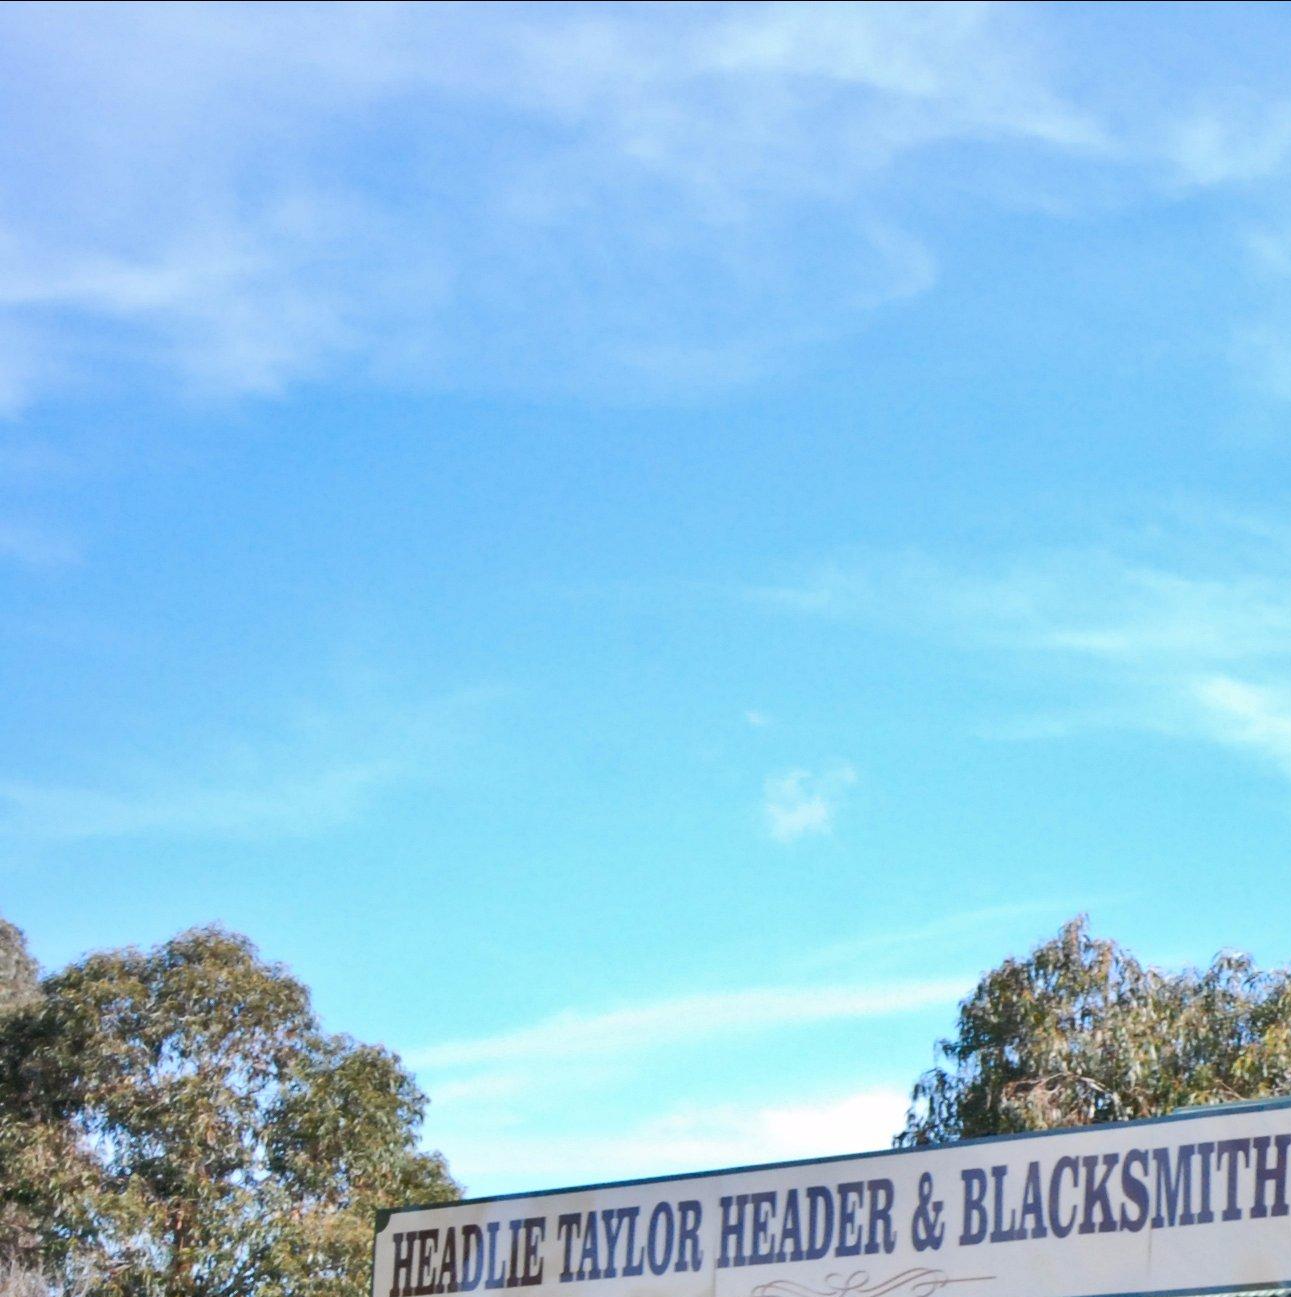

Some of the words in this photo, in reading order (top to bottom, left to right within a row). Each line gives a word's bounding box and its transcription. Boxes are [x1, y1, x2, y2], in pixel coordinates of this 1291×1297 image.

[557, 1200, 704, 1283] TAYLOR
[716, 1178, 896, 1268] HEADER
[911, 1171, 946, 1252] &
